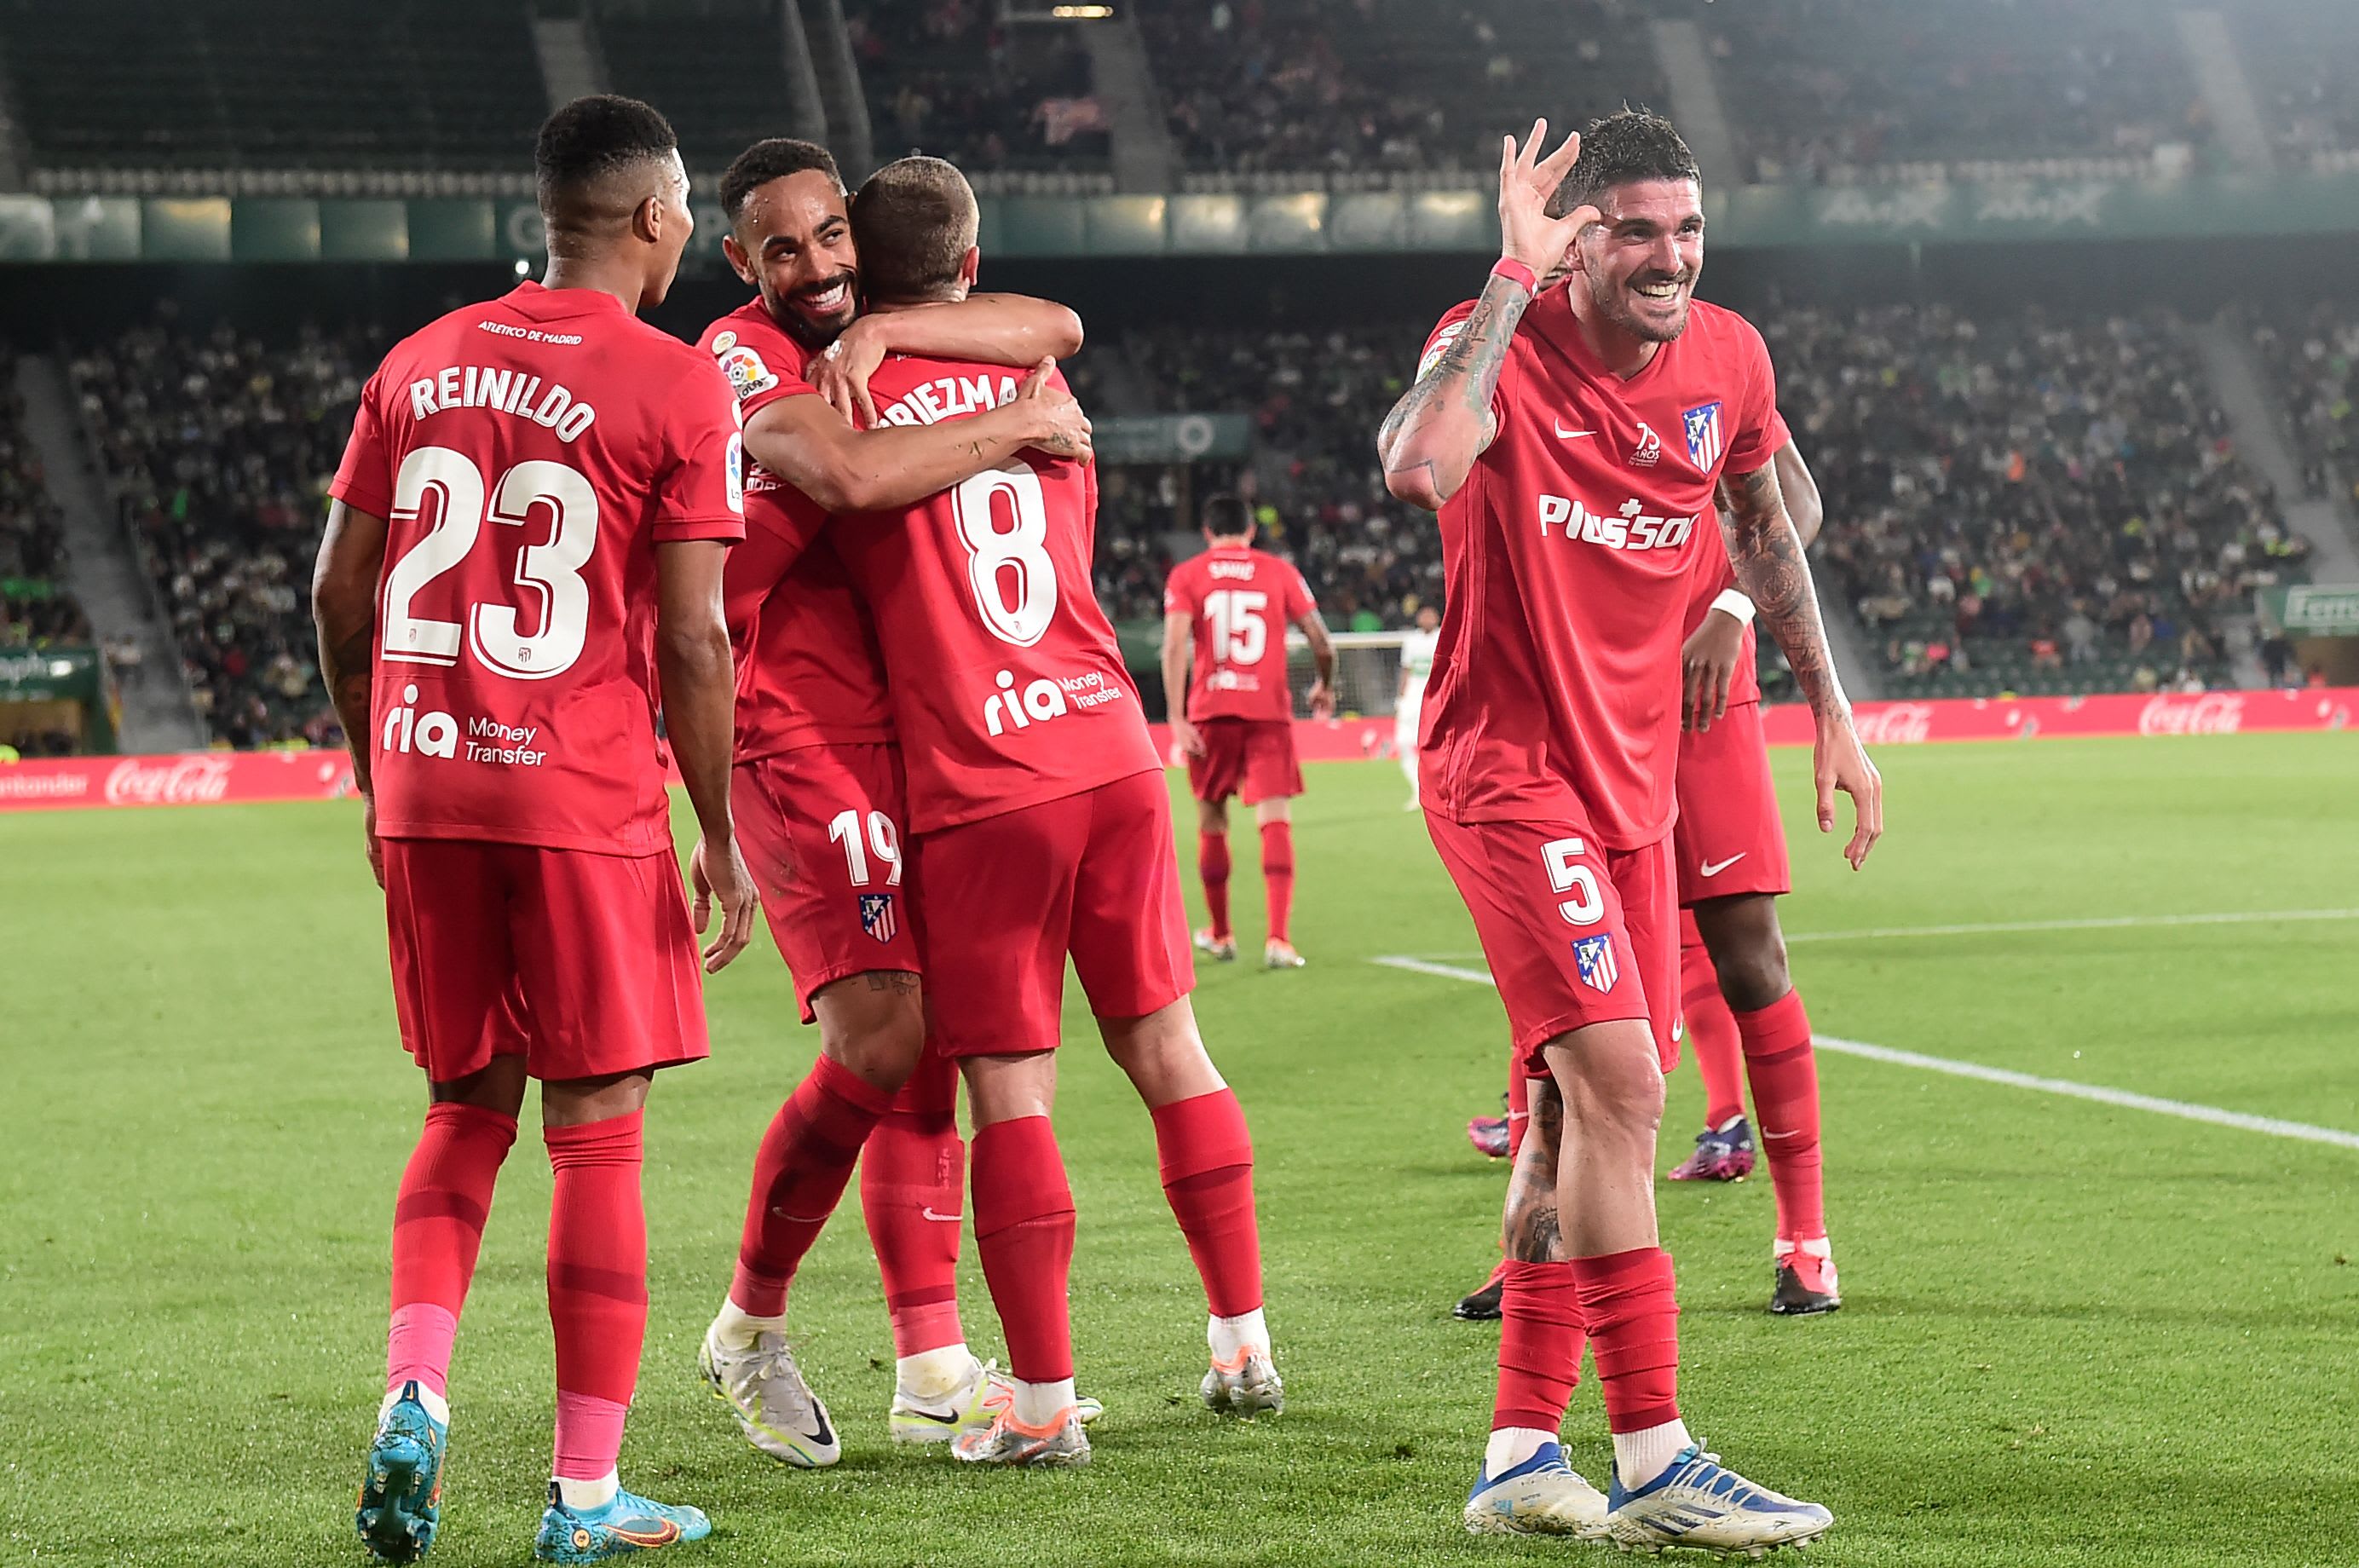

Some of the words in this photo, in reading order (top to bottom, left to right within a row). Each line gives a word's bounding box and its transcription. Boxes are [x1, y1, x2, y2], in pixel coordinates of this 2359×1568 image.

[527, 330, 543, 342] DE
[542, 333, 582, 345] MADRID
[409, 366, 596, 443] REINILDO
[878, 374, 1018, 427] RIEZMA
[381, 447, 599, 680] 23
[950, 457, 1058, 648] 8
[1203, 589, 1268, 666] 15
[983, 670, 1067, 737] ria
[1056, 671, 1104, 692] Money
[1069, 687, 1122, 710] Transfer
[384, 684, 459, 758] ria
[465, 743, 546, 767] Transfer
[468, 716, 537, 746] Money
[828, 810, 903, 887] 19
[1540, 838, 1605, 925] 5
